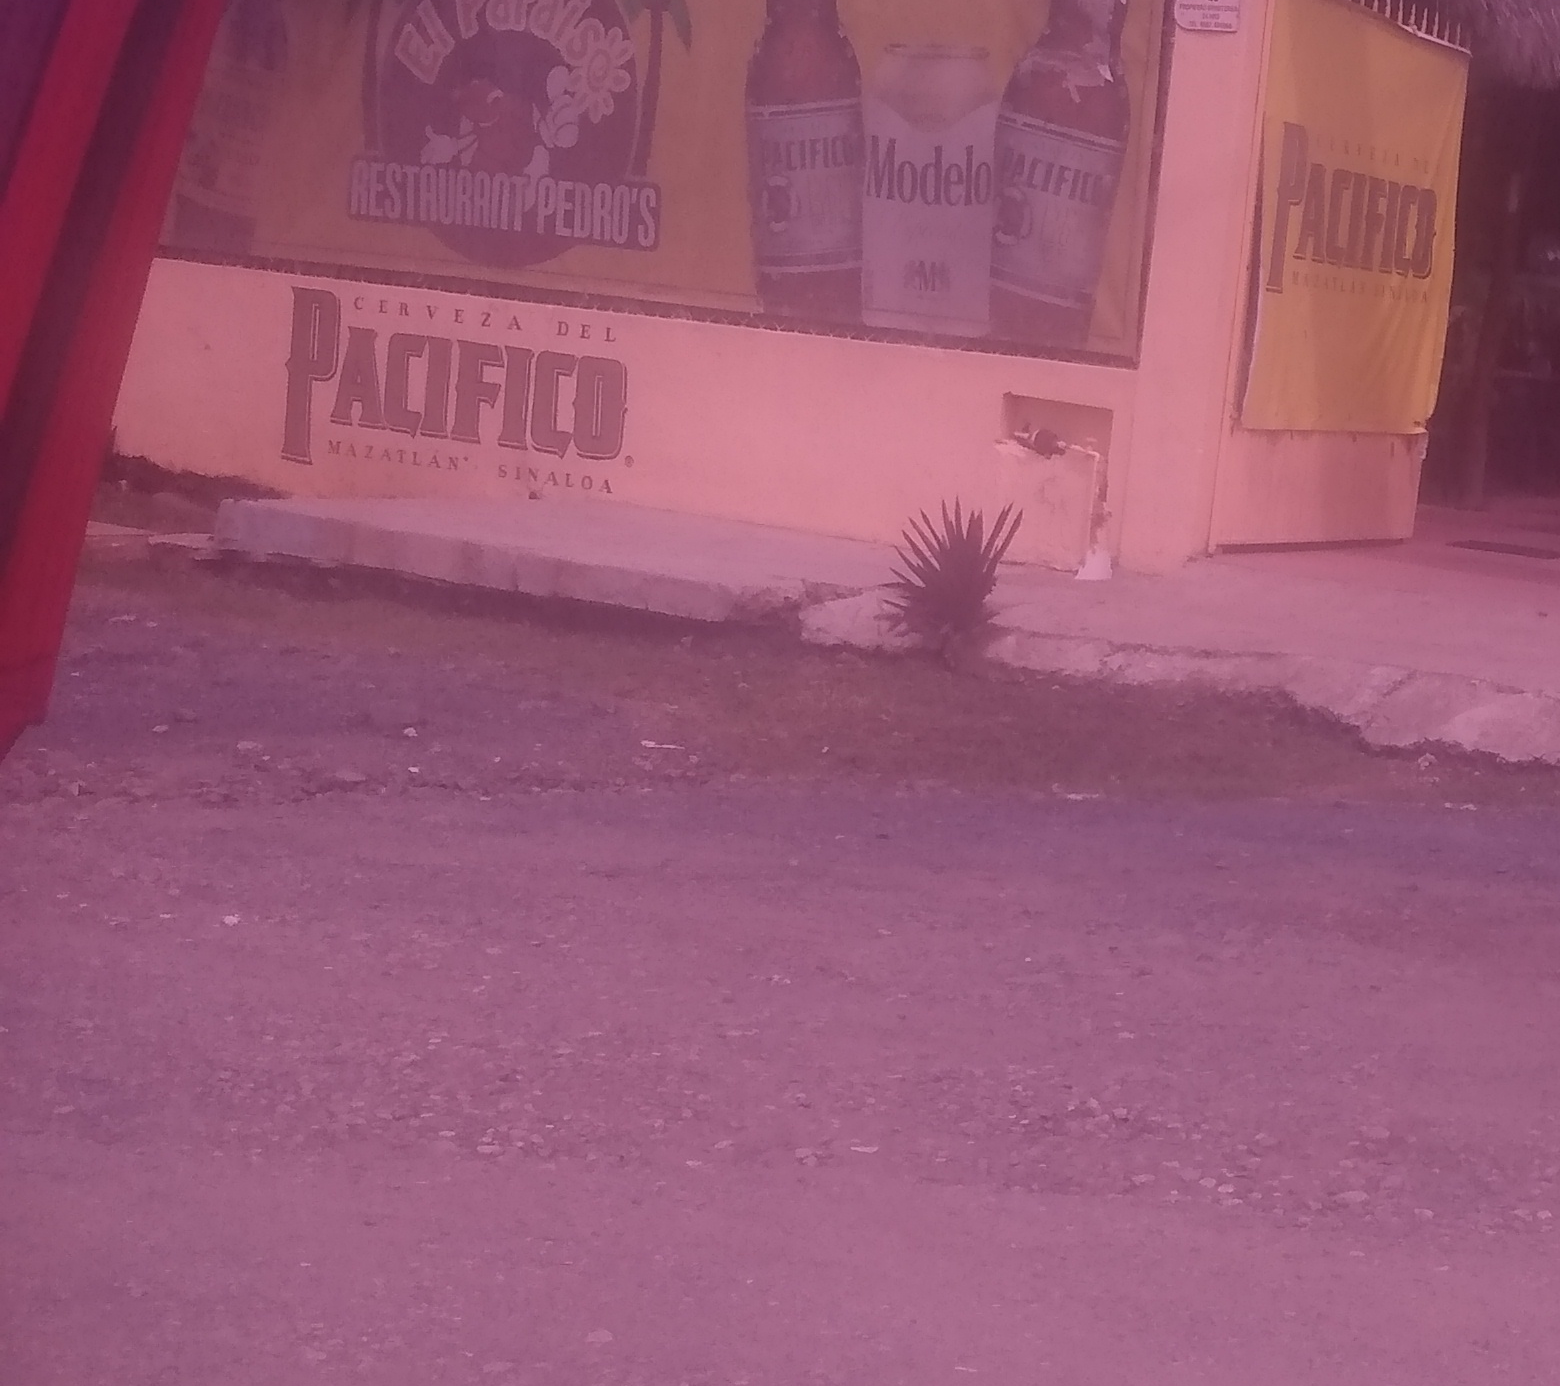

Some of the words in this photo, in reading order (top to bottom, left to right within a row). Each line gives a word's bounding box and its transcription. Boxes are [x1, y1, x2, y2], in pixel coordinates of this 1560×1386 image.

[350, 160, 528, 232] RESTAURANT
[537, 176, 657, 247] PEDRO'S
[866, 135, 992, 206] Modelo
[1266, 121, 1438, 294] PACIFICO
[354, 297, 523, 331] CERVEZA
[557, 321, 617, 343] DEL
[281, 286, 629, 466] PACIFICO
[497, 465, 613, 494] SINALOA
